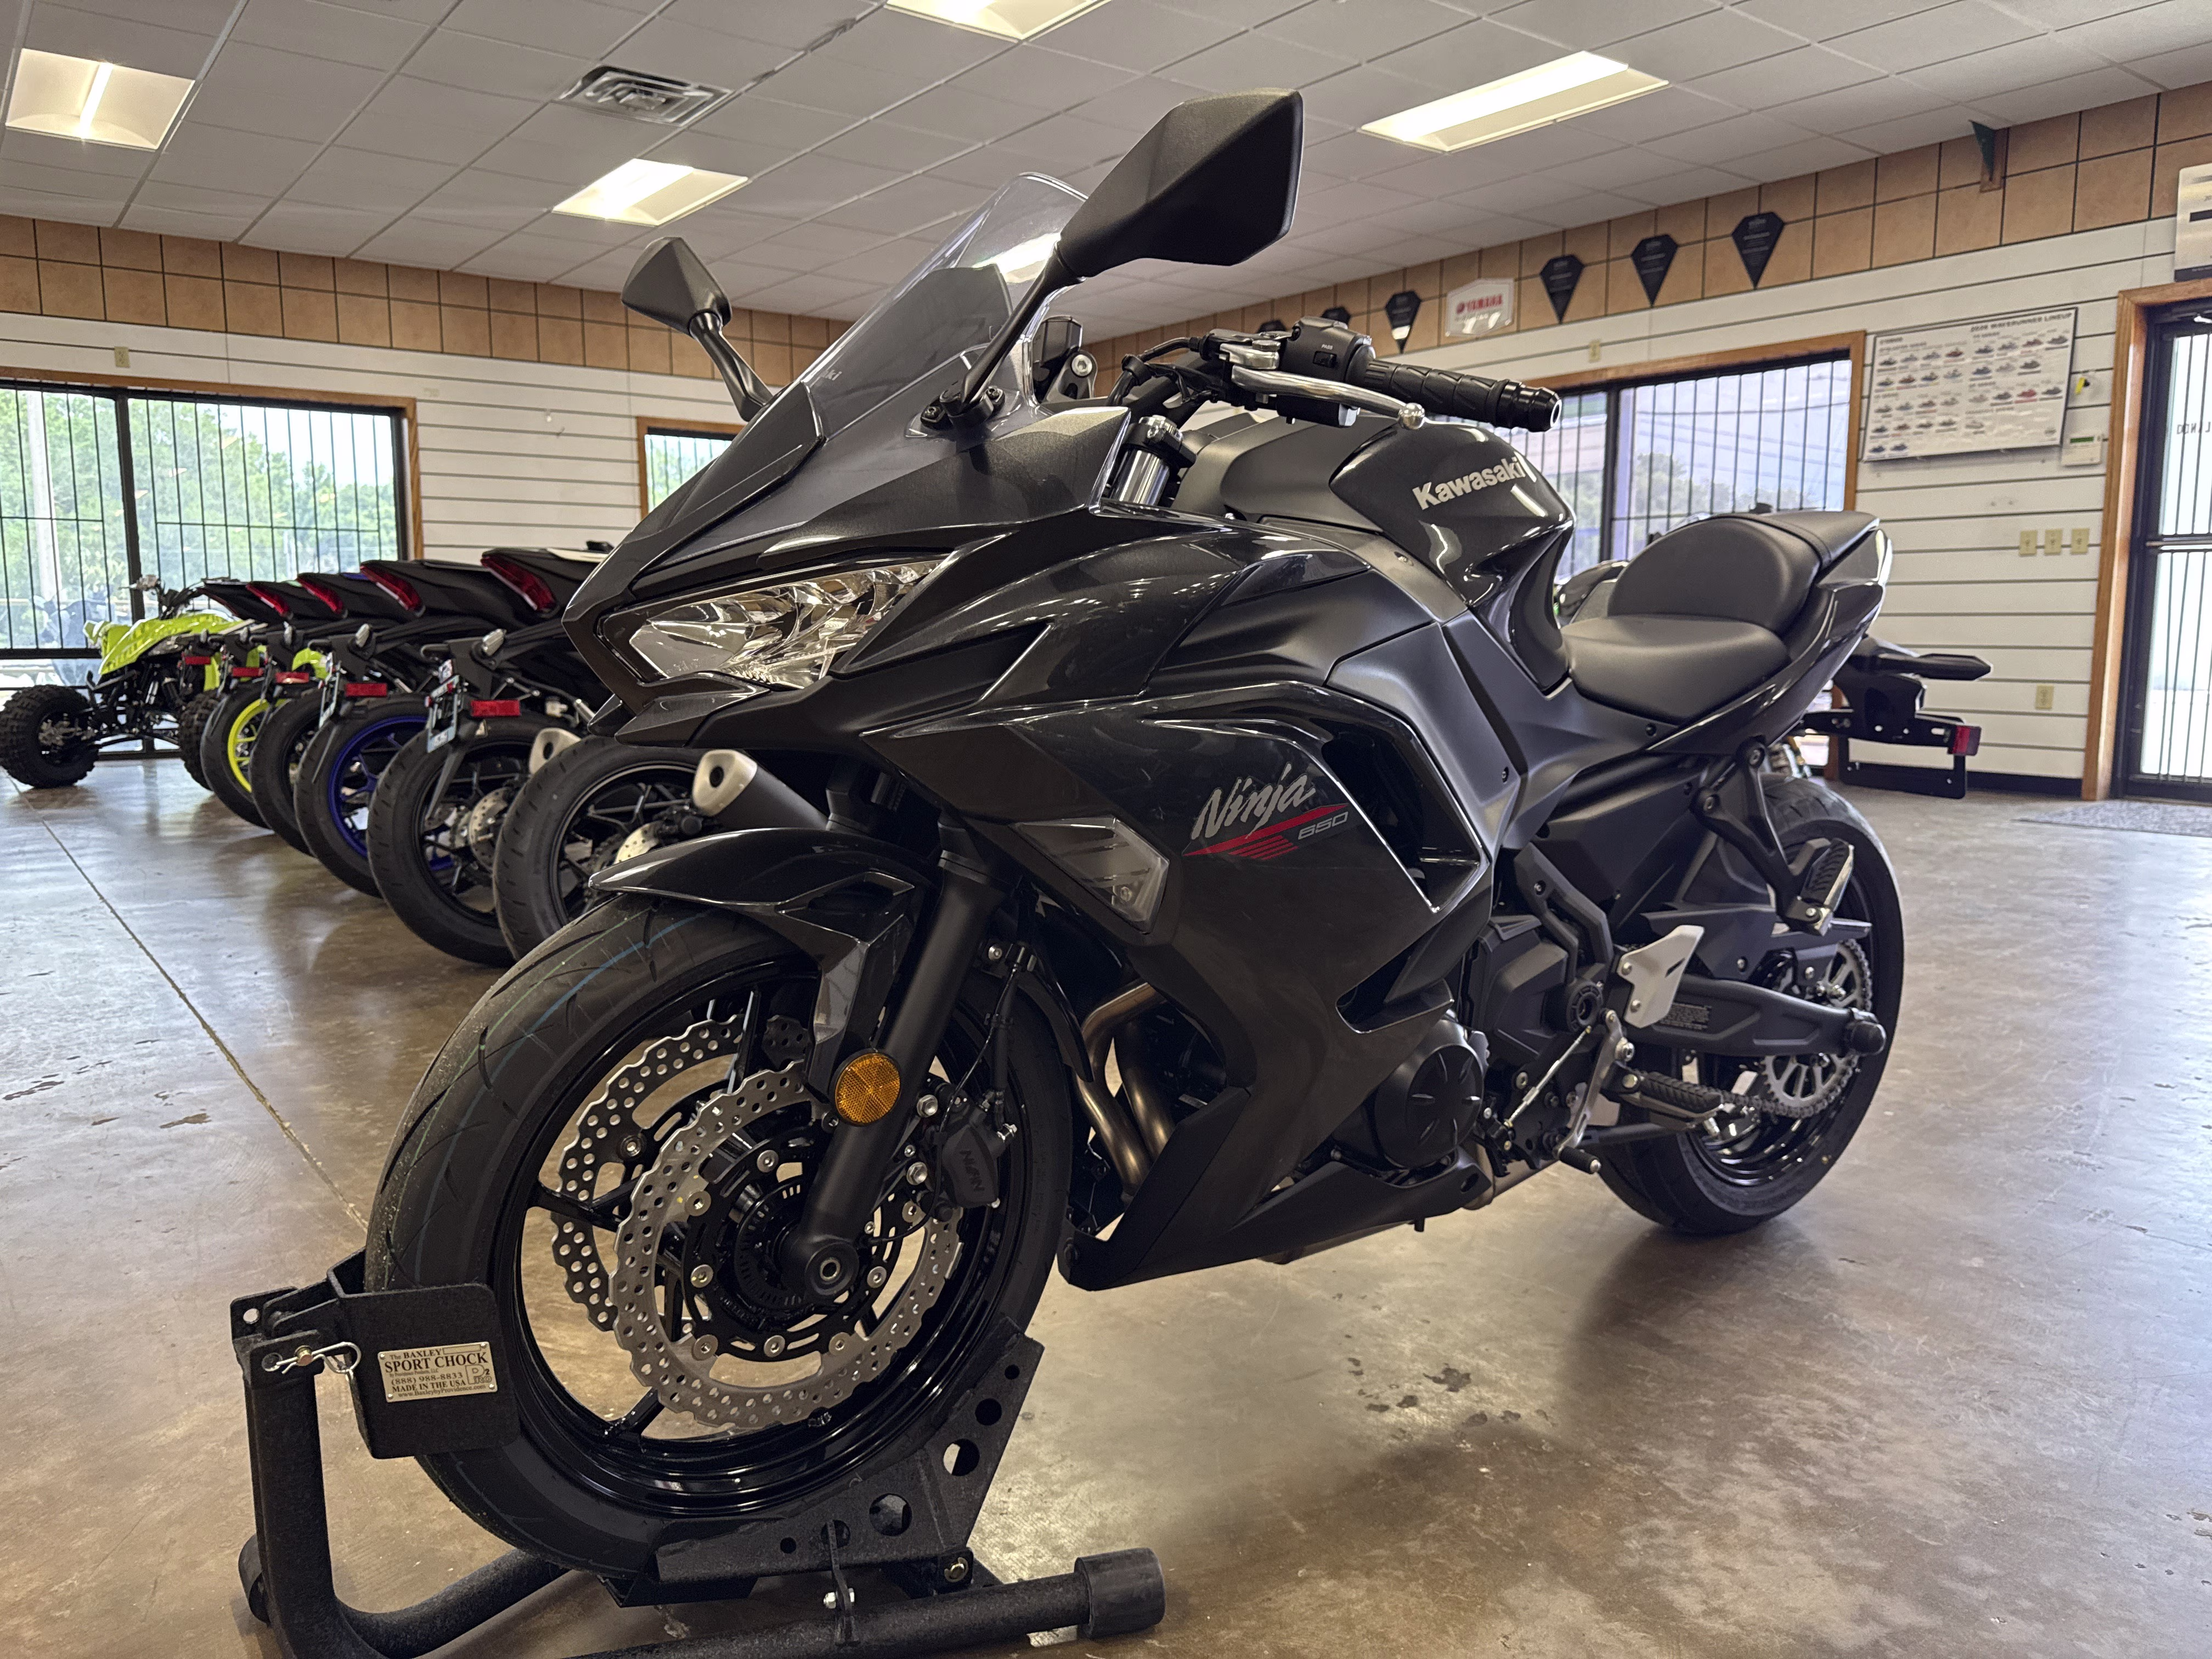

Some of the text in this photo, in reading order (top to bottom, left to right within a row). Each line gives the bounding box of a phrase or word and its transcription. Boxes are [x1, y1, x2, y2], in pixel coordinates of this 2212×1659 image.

[1412, 456, 1526, 510] Kawasaki
[1190, 761, 1317, 840] Ninja
[1298, 811, 1348, 840] 650
[385, 1352, 488, 1373] SPORT CHOCK
[403, 1348, 441, 1359] BAXLEY
[391, 1372, 462, 1386] (888) 988-8833
[392, 1384, 417, 1393] MADE
[430, 1381, 448, 1389] THE
